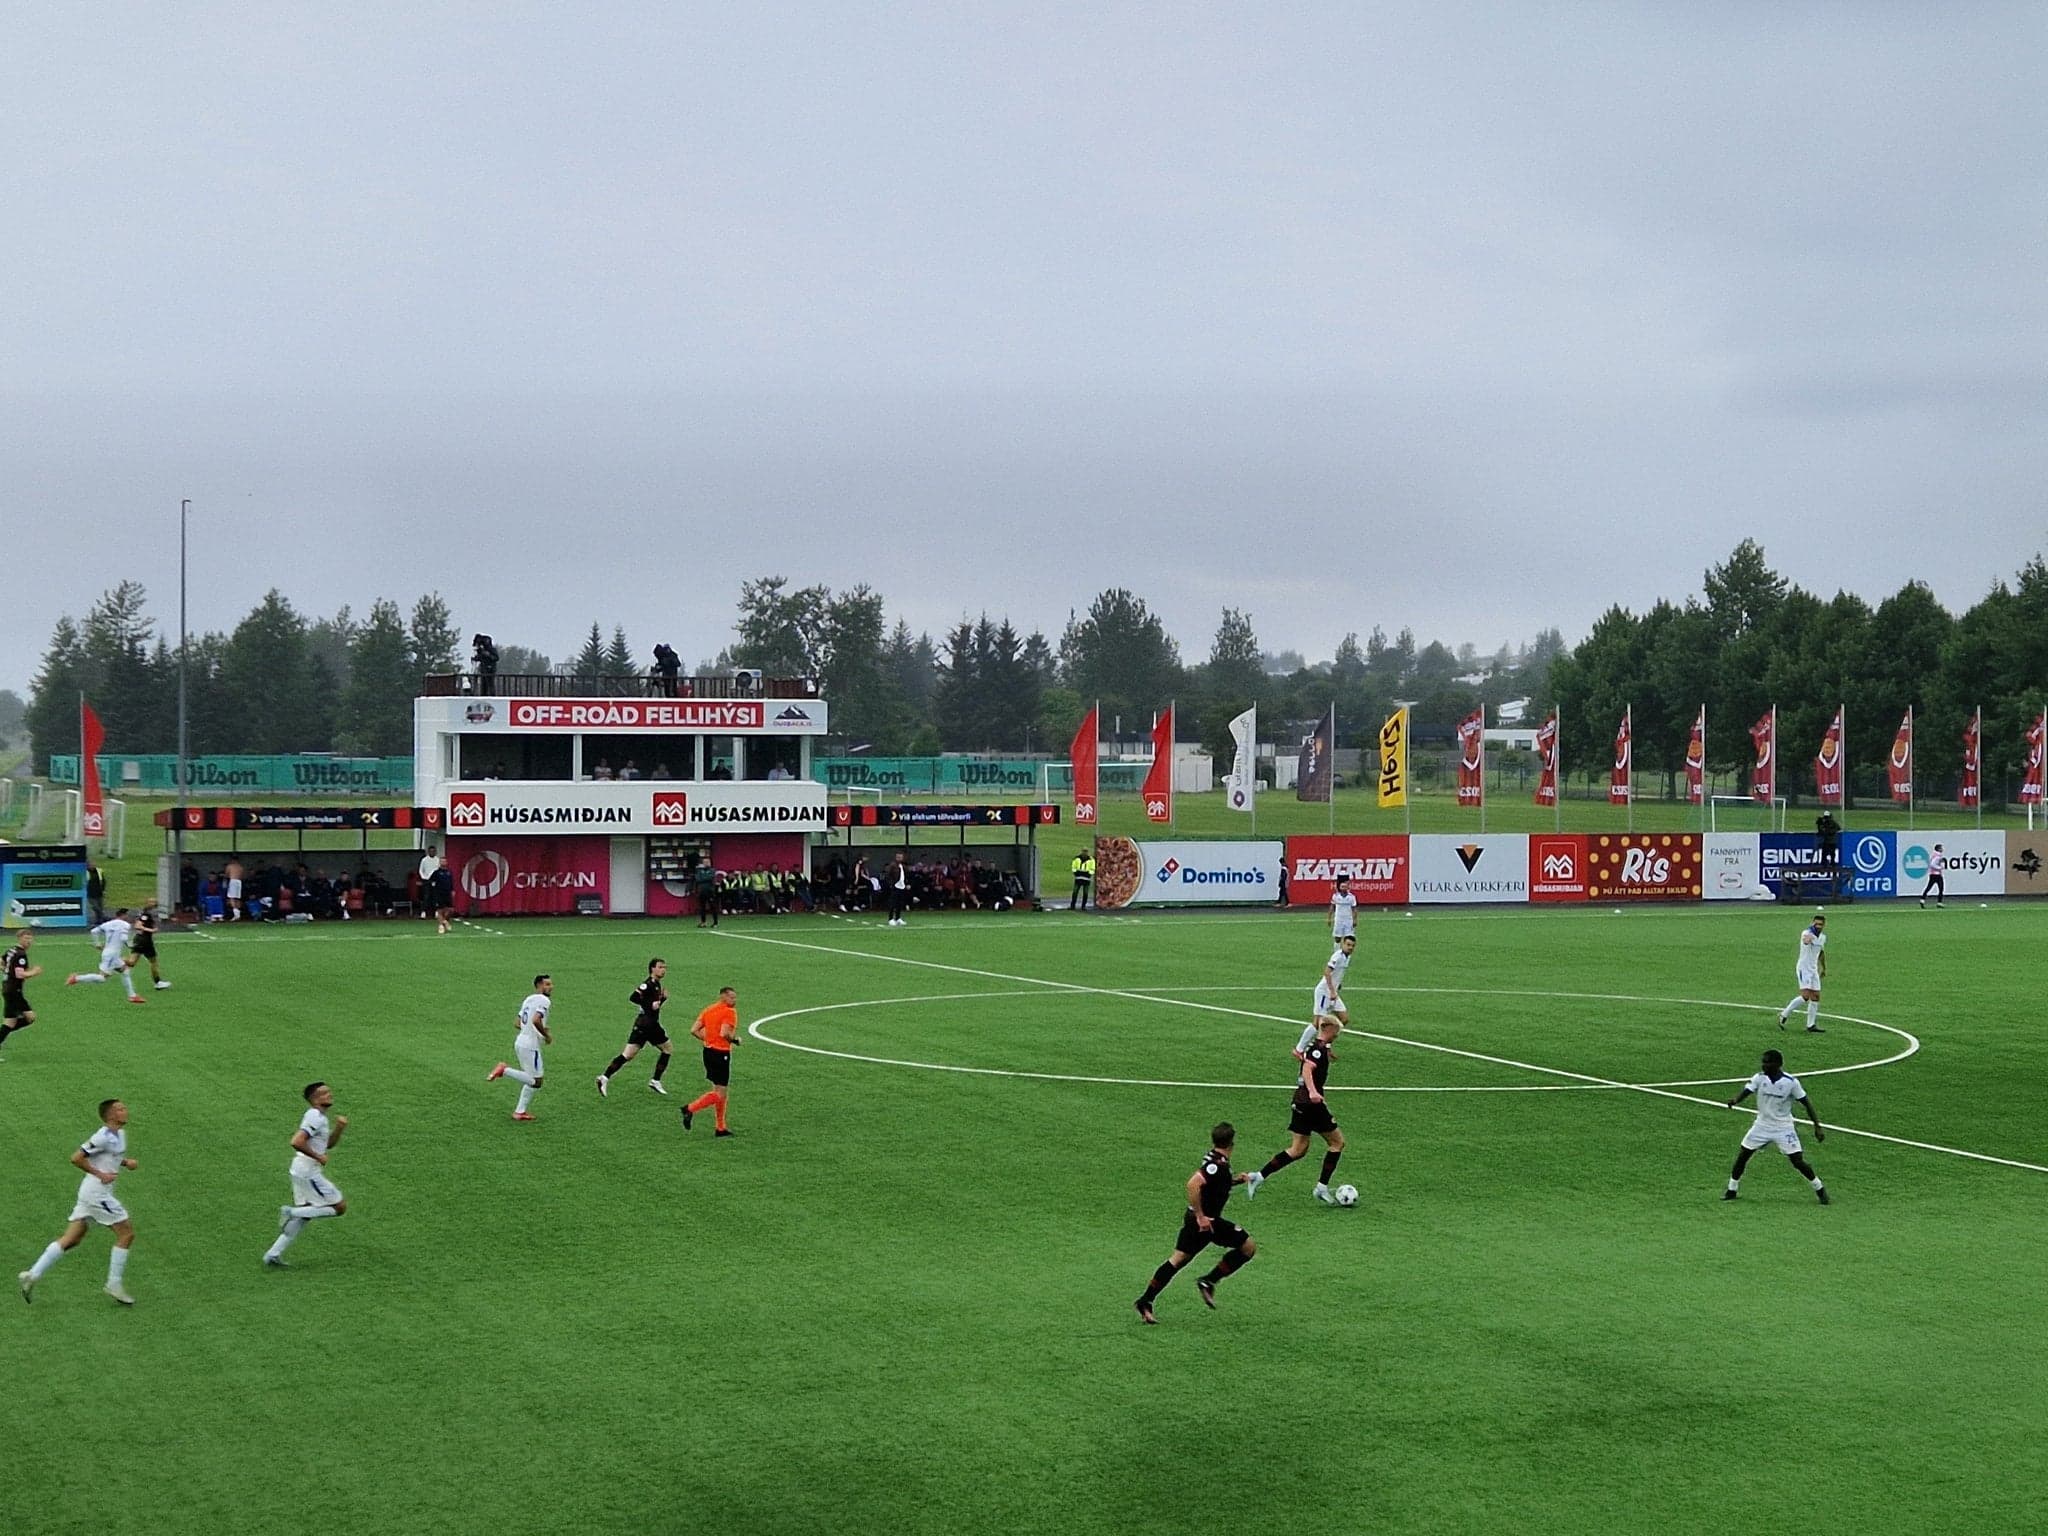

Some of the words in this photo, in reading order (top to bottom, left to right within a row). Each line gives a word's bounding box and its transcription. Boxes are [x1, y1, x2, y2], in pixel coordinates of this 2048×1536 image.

[646, 703, 756, 725] FELLIHÝSI
[168, 763, 260, 785] Wilson
[293, 763, 380, 785] Wilson
[826, 764, 904, 785] Wilson
[958, 763, 1033, 785] Wilson
[490, 804, 632, 823] HÚSASMIÐJAN
[690, 803, 825, 822] HÚSASMIÐJAN
[1182, 867, 1265, 883] Domino's
[1293, 858, 1397, 880] KATRIN
[1621, 847, 1670, 883] Rís
[1454, 881, 1462, 892] &
[1848, 875, 1892, 892] erra
